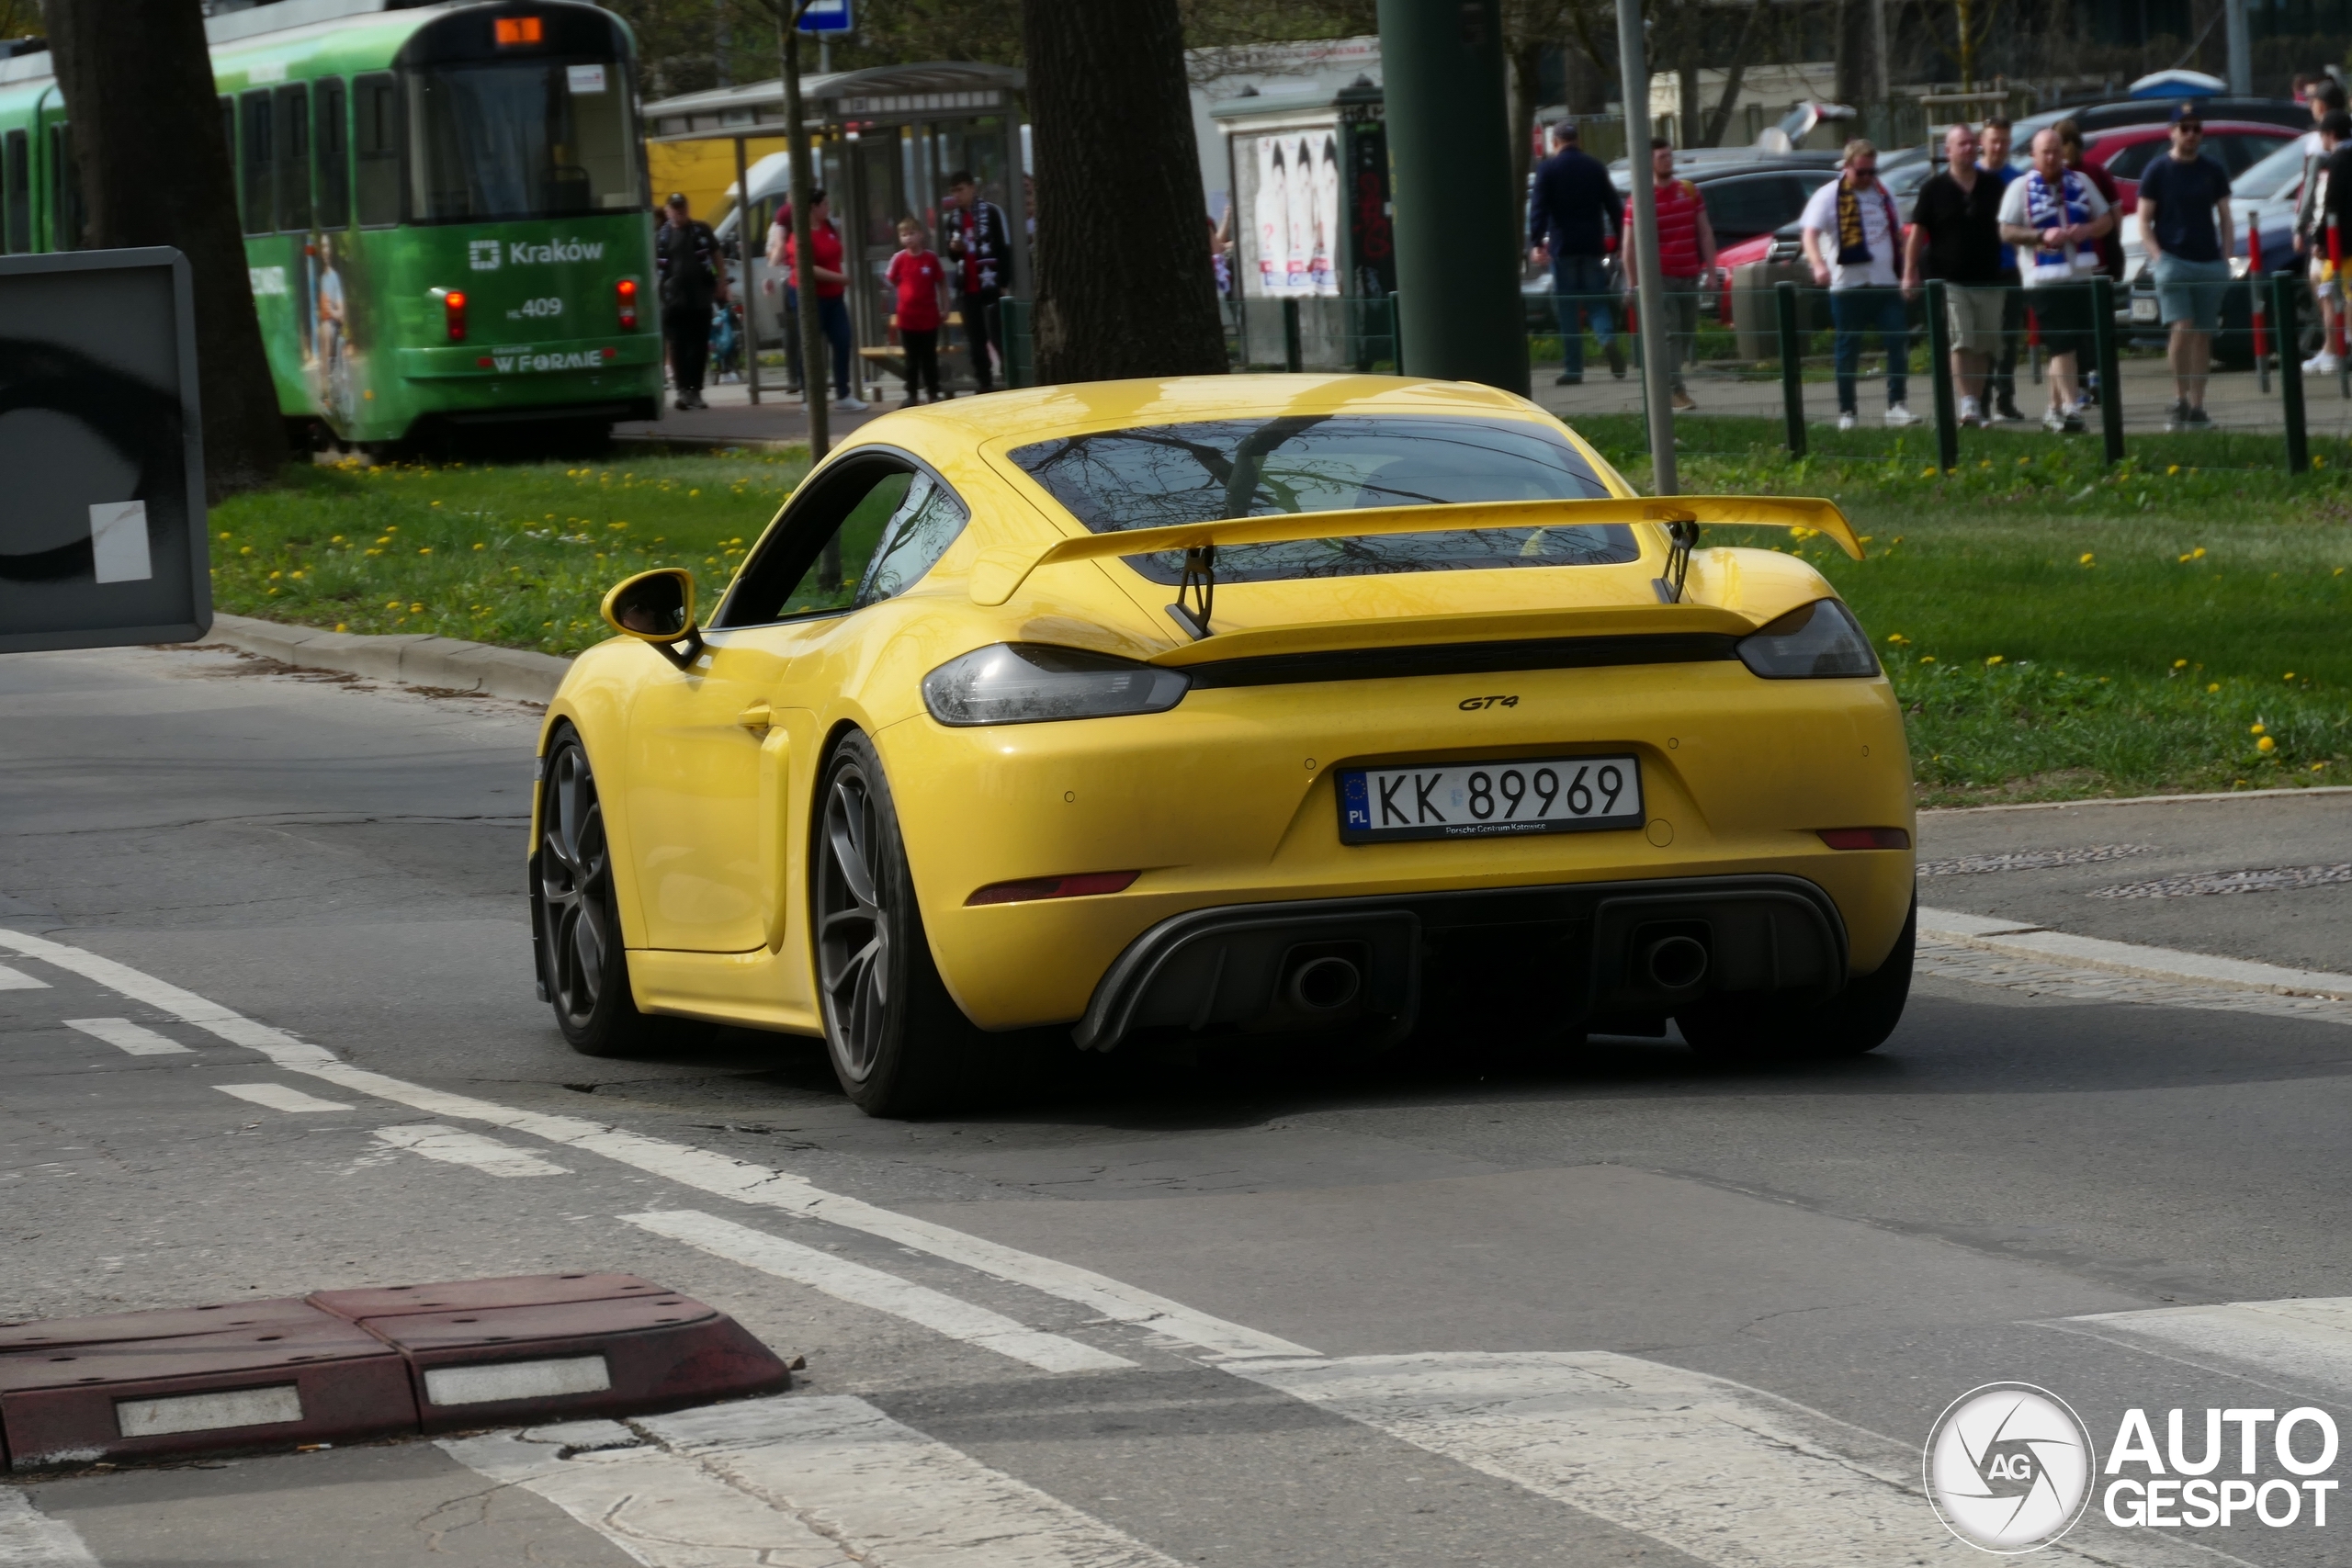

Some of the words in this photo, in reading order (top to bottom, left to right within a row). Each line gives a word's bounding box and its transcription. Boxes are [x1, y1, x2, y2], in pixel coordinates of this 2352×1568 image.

[509, 236, 604, 265] Kraków
[521, 297, 563, 318] 409
[493, 356, 514, 373] W
[1458, 694, 1521, 712] GT4
[1378, 773, 1447, 826] KK
[1467, 765, 1623, 819] 89969
[1349, 809, 1368, 824] PL
[1445, 826, 1476, 835] Porsche
[1477, 825, 1510, 834] Centrum
[1511, 822, 1546, 831] Katowice
